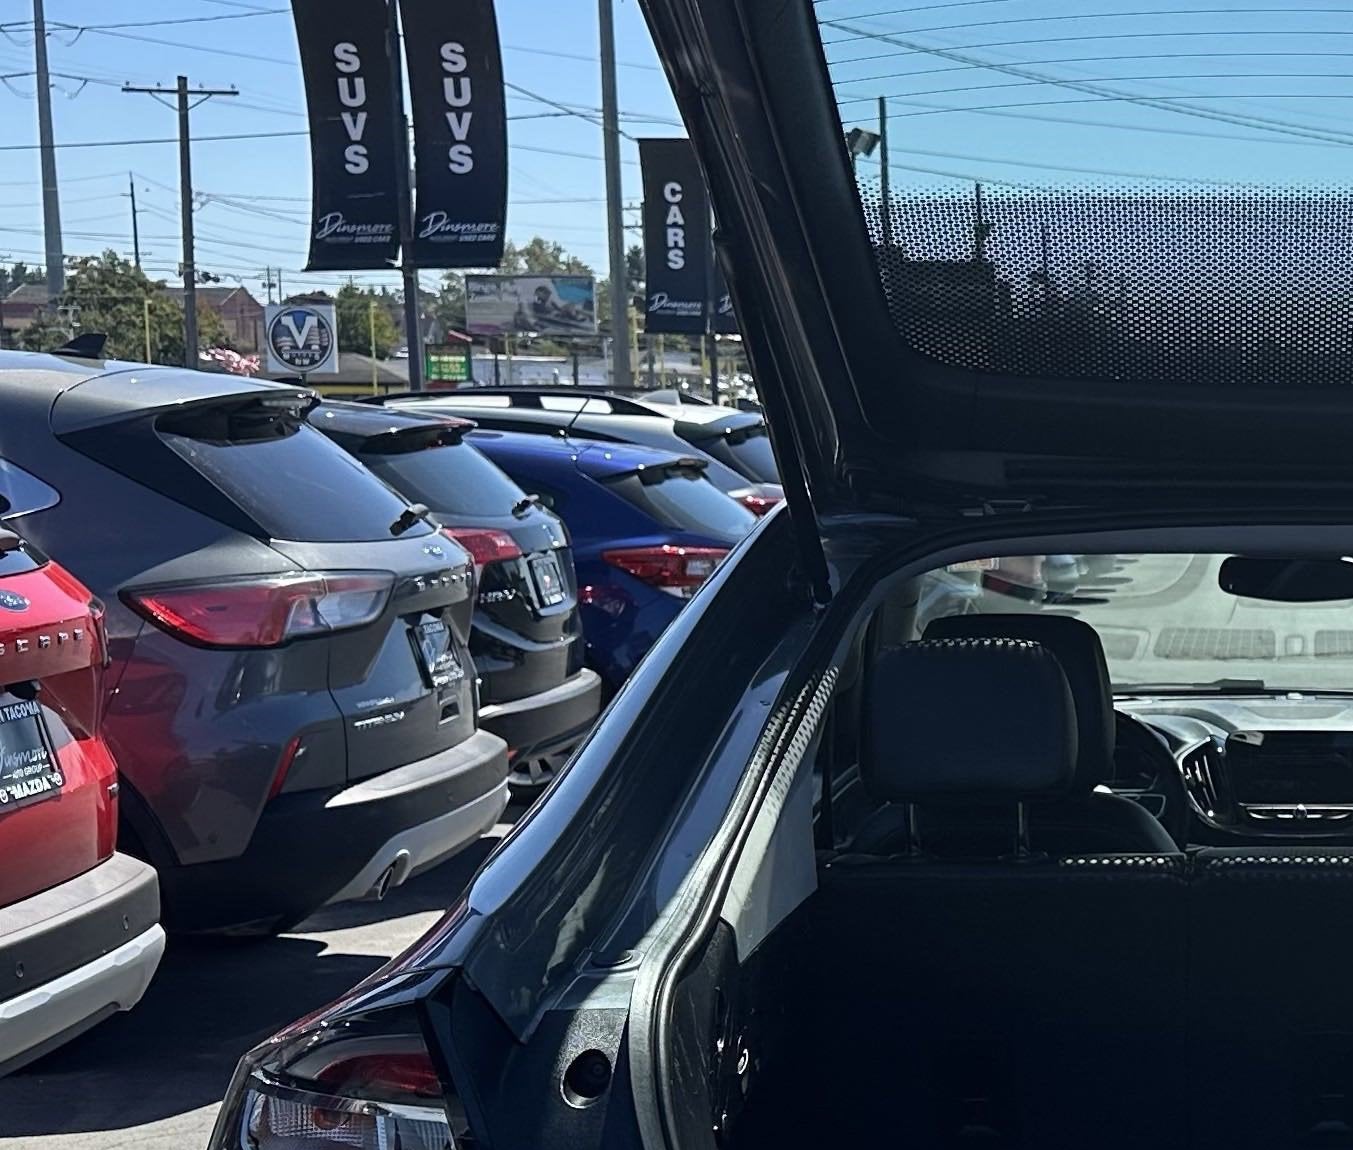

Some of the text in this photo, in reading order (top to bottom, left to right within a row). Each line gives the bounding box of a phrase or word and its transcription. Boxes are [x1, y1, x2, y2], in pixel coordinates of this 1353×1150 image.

[333, 42, 369, 174] SUVS
[440, 42, 474, 174] SUVS
[315, 211, 395, 239] Dinsmore
[419, 210, 500, 238] Dinsmore
[664, 182, 685, 270] CARS
[4, 700, 40, 722] TACOMA
